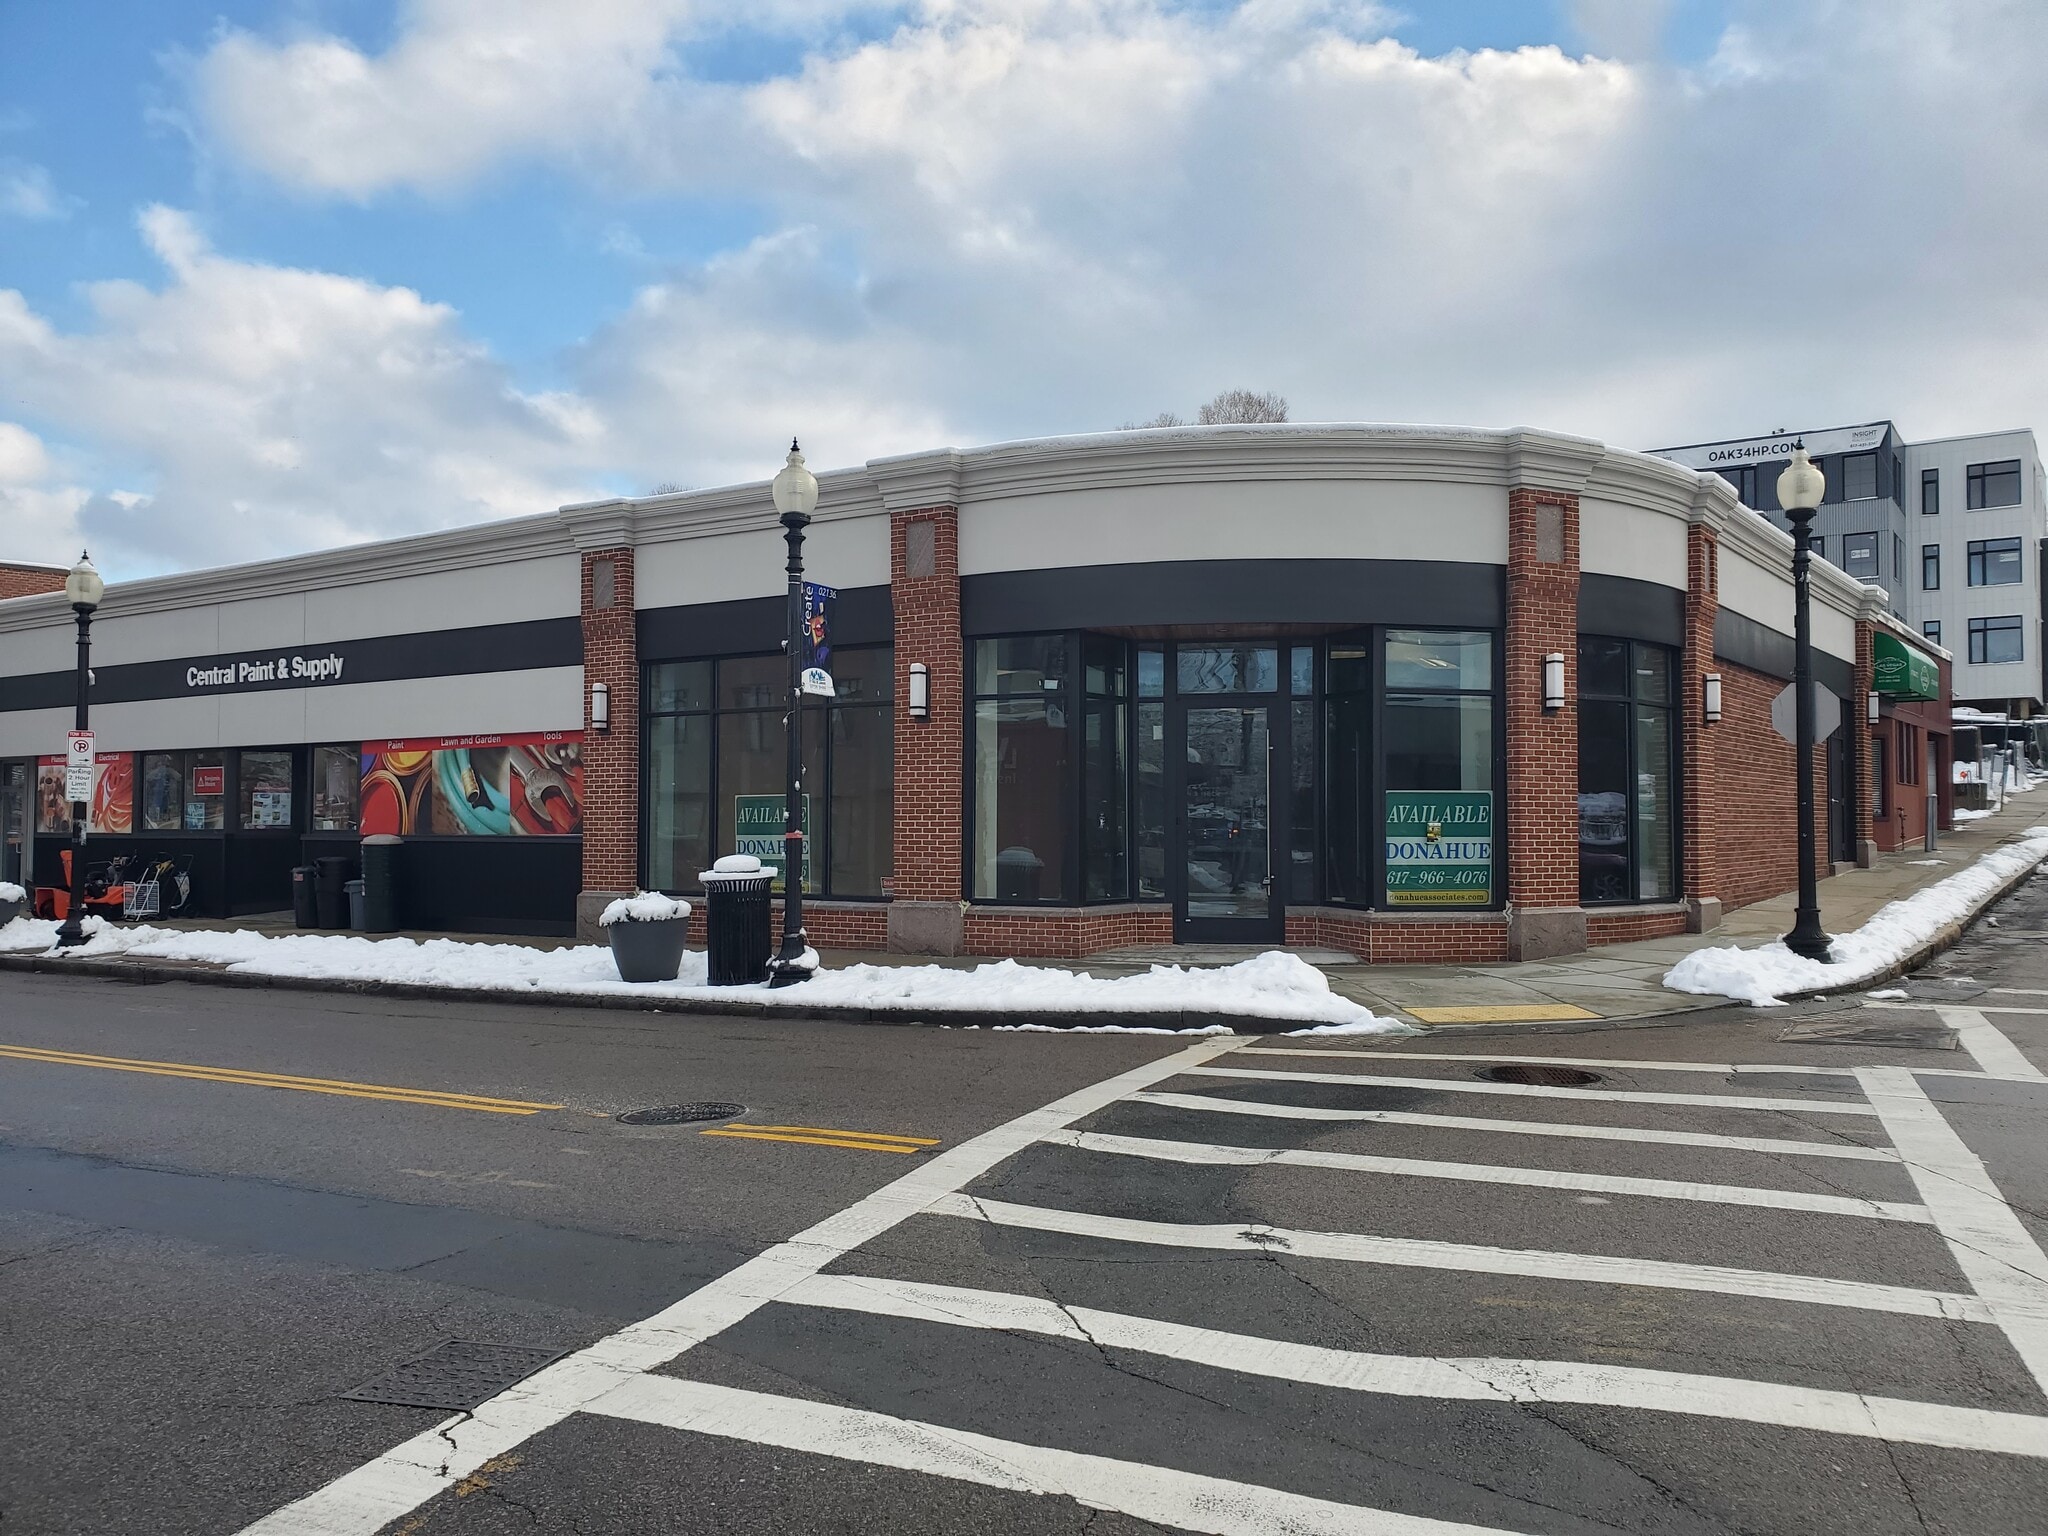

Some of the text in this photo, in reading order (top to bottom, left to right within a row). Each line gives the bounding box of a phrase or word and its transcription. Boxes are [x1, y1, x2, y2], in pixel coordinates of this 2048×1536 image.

[818, 587, 837, 599] 02136
[803, 586, 814, 636] Create
[186, 653, 344, 687] Central Paint & Supply
[441, 735, 501, 746] Lawn and Garden
[542, 731, 562, 740] Tools
[387, 741, 404, 749] Paint
[738, 807, 807, 823] AVAILAE
[1386, 805, 1489, 823] AVAILABLE
[737, 840, 808, 855] DONAHE
[1386, 842, 1491, 859] DONAHUE
[1386, 870, 1487, 884] 617-966-4076
